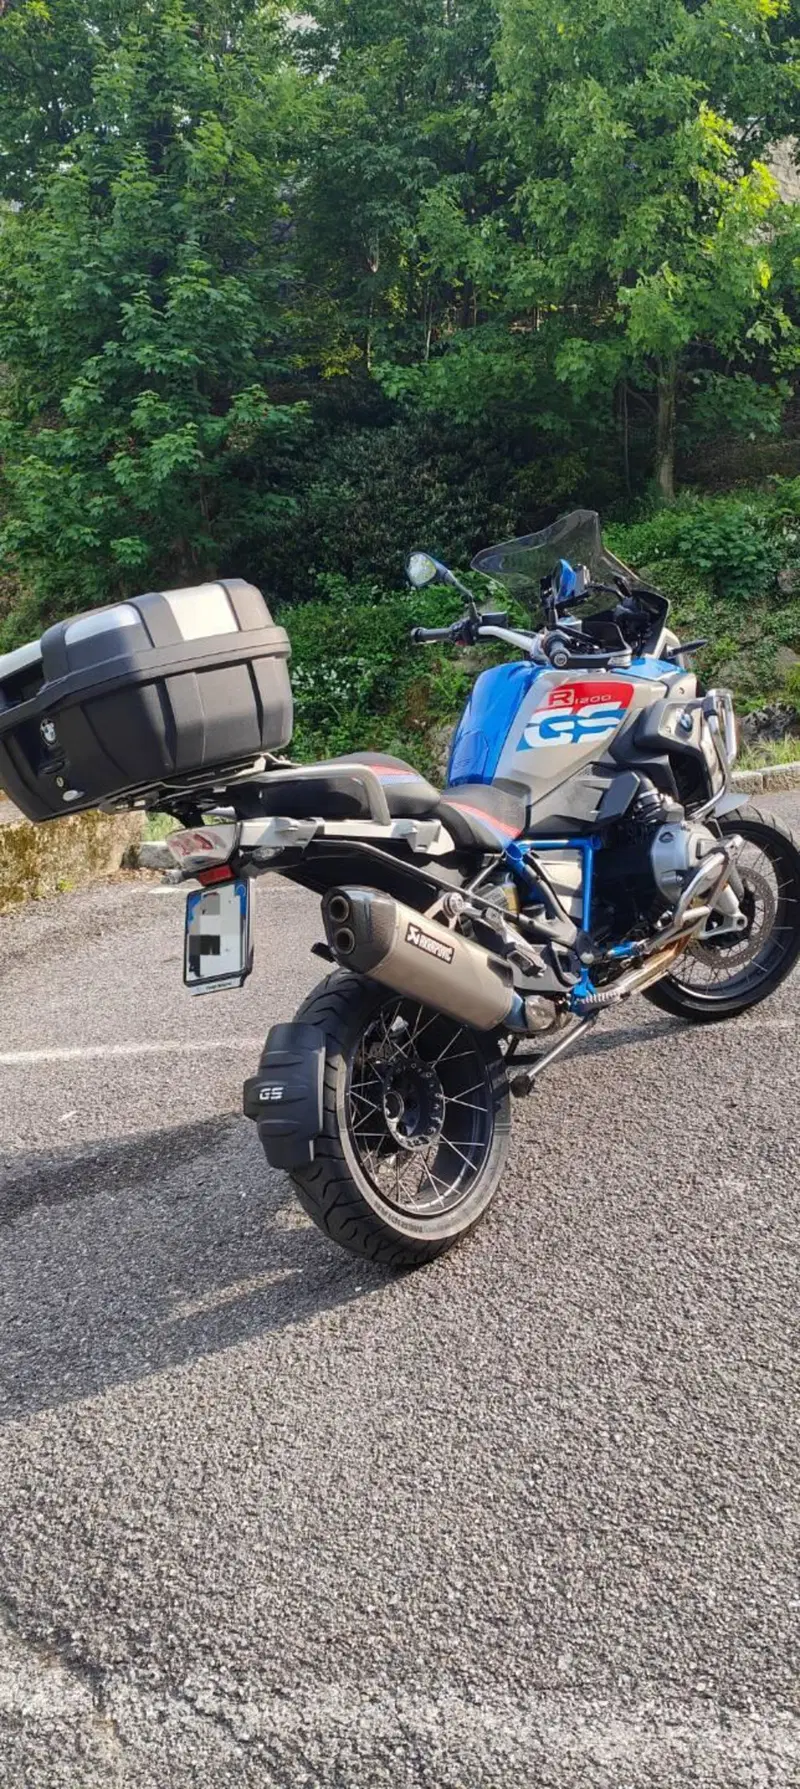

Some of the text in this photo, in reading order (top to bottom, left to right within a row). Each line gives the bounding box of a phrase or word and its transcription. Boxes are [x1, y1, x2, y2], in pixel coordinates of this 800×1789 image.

[548, 689, 612, 707] R 1200
[524, 701, 622, 747] GS
[259, 1086, 284, 1100] GS
